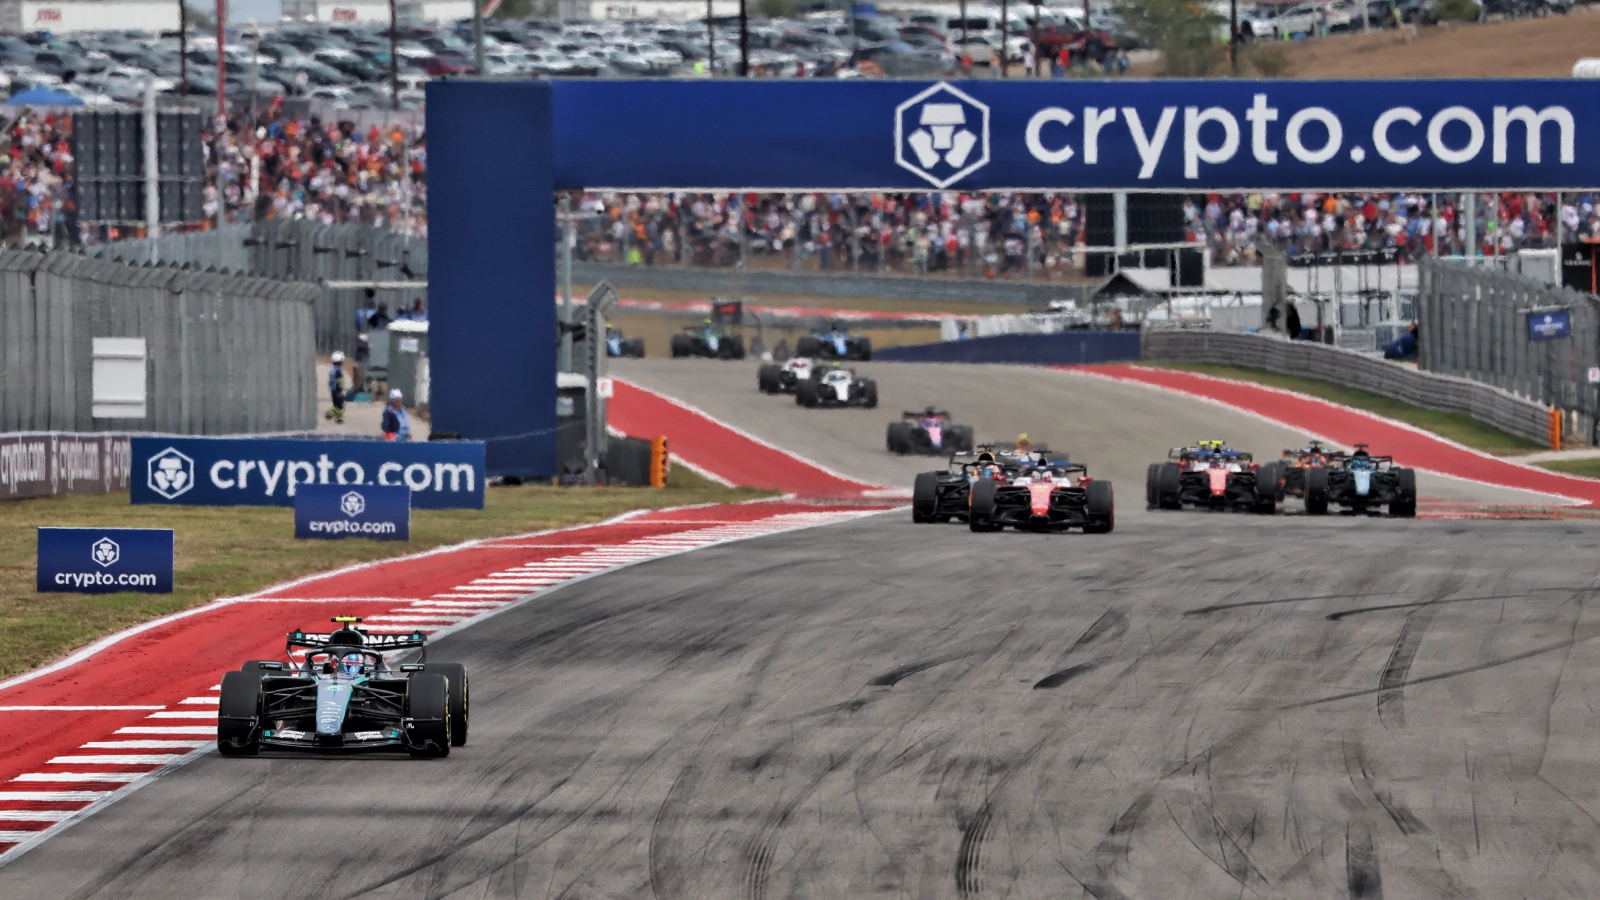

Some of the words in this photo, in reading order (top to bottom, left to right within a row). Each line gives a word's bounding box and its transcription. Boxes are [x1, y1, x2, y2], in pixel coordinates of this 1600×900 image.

[1025, 94, 1575, 179] crypto.com
[209, 453, 475, 497] crypto.com
[309, 519, 396, 534] crypto.com
[55, 571, 156, 587] crypto.com
[305, 633, 409, 645] PEONAS
